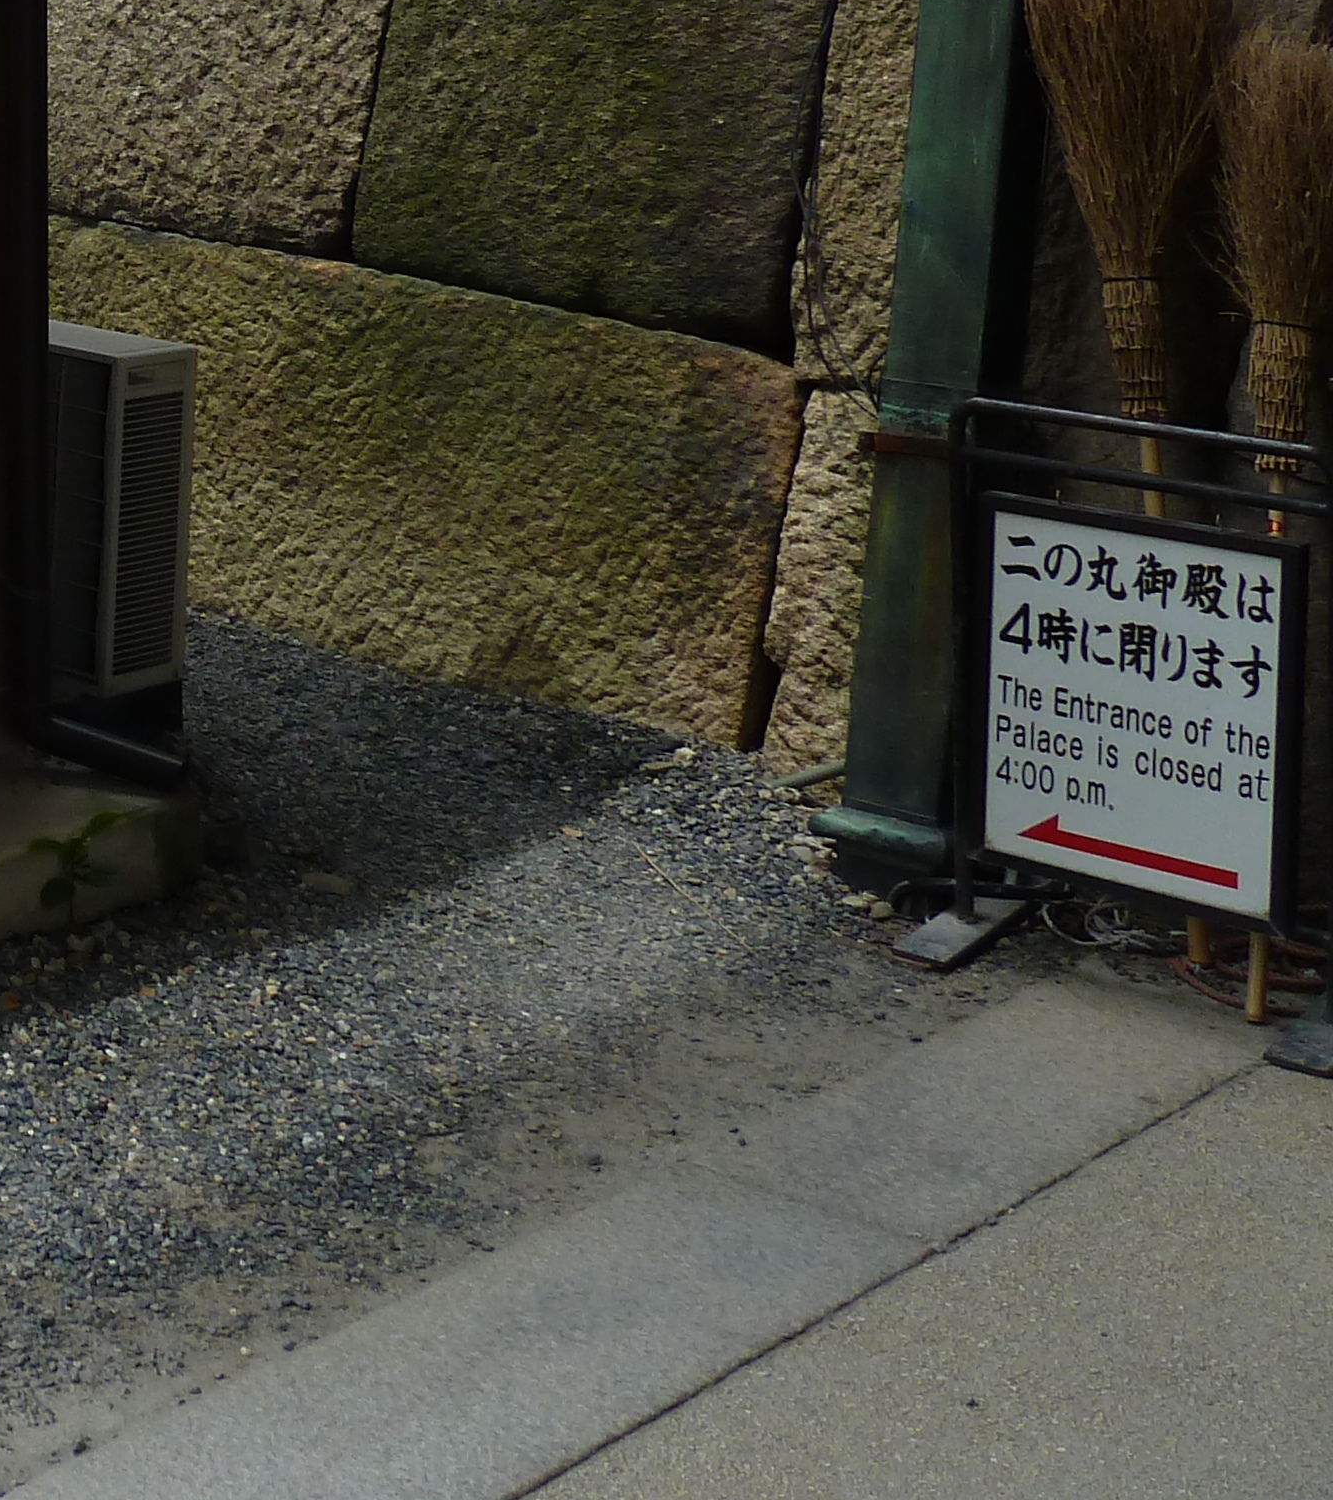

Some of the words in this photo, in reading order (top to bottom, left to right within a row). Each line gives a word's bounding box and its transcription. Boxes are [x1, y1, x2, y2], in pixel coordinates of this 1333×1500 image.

[999, 533, 1276, 624] 二の丸御殿は
[998, 601, 1273, 699] 4時に閉ります
[995, 715, 1084, 762] Palace
[1097, 737, 1120, 769] is
[1134, 745, 1223, 793] closed
[1238, 769, 1271, 803] at
[996, 674, 1044, 711] The
[1053, 687, 1173, 740] Entrance
[1184, 718, 1213, 747] of
[1224, 721, 1271, 761] the
[995, 755, 1055, 795] 4:00
[1065, 775, 1116, 811] p.m.
